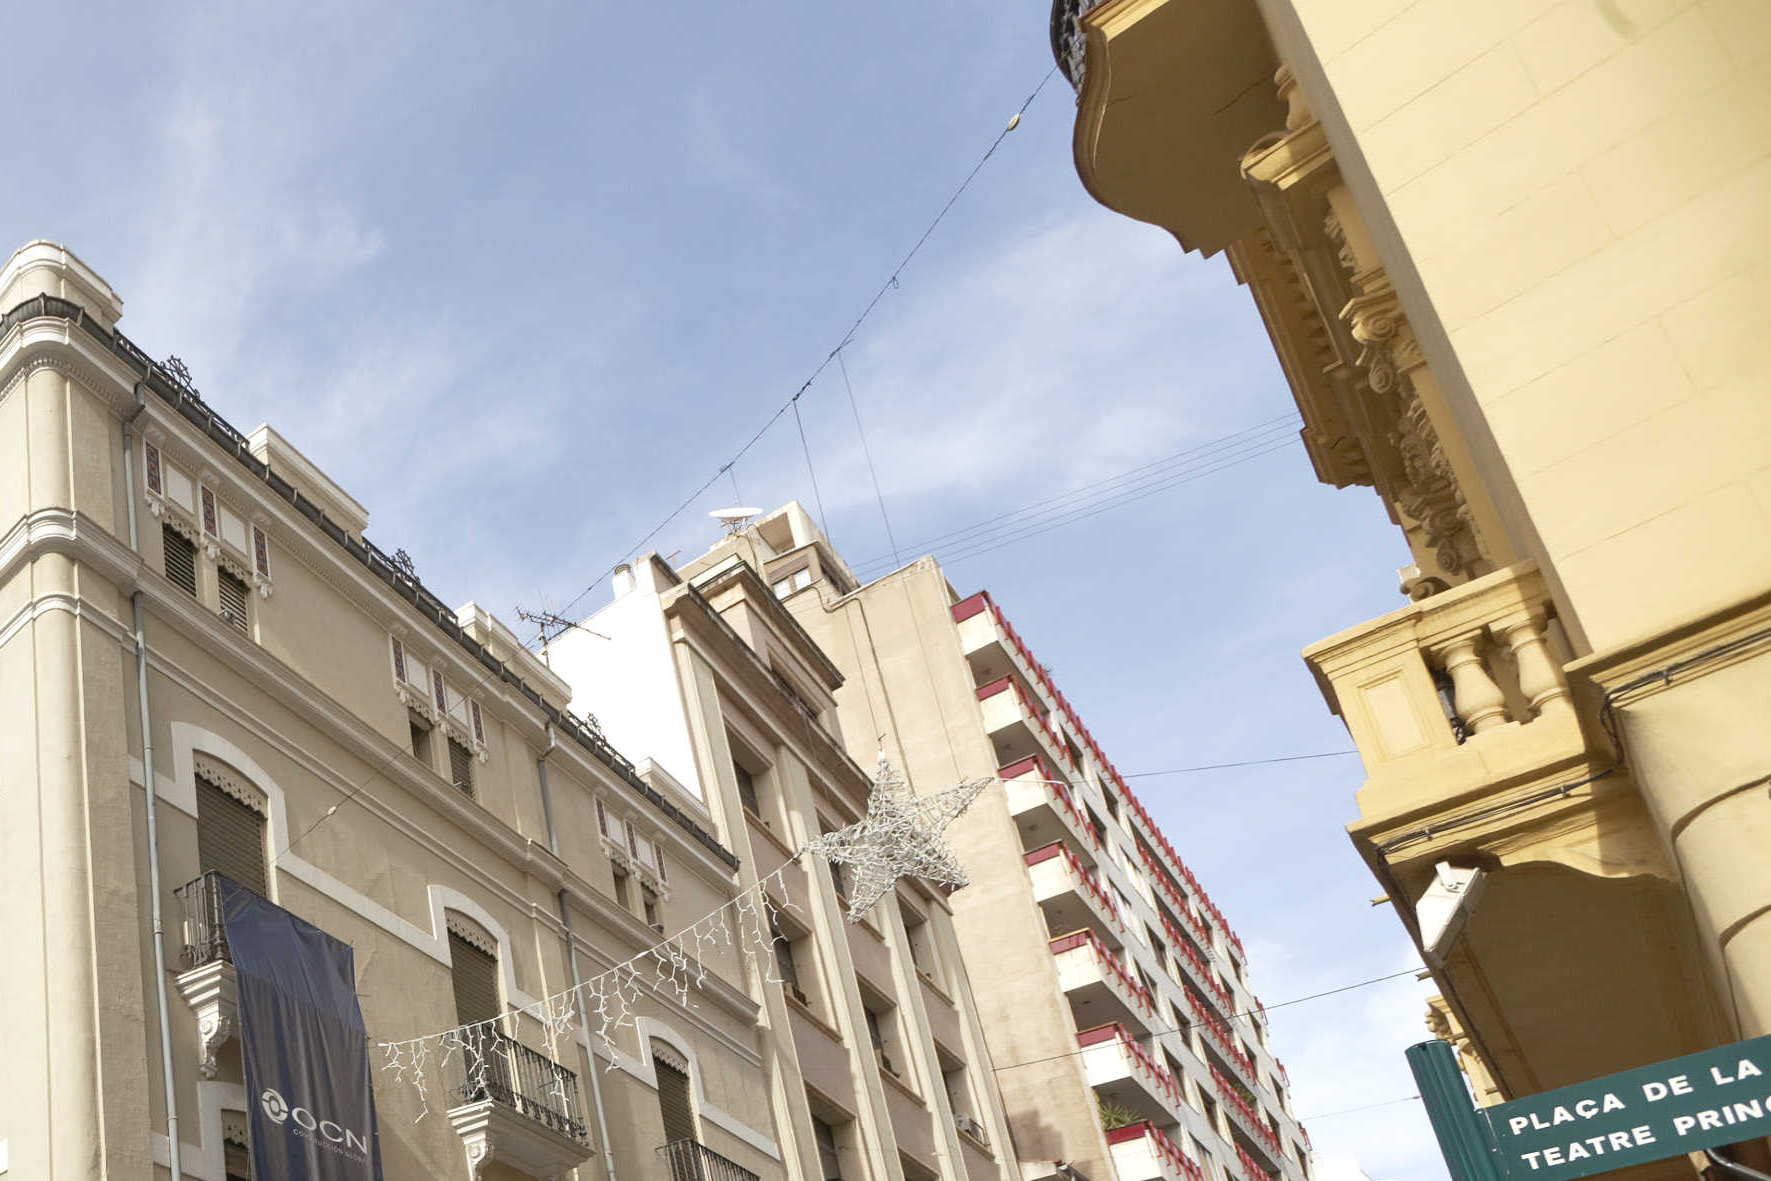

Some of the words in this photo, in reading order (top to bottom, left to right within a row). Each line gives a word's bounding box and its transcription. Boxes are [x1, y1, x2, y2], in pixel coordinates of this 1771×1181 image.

[1508, 1093, 1626, 1135] PLAÇA
[1642, 1074, 1694, 1102] DE
[1709, 1058, 1763, 1086] LA
[291, 1107, 368, 1154] OCN
[1521, 1125, 1657, 1170] TEATRE
